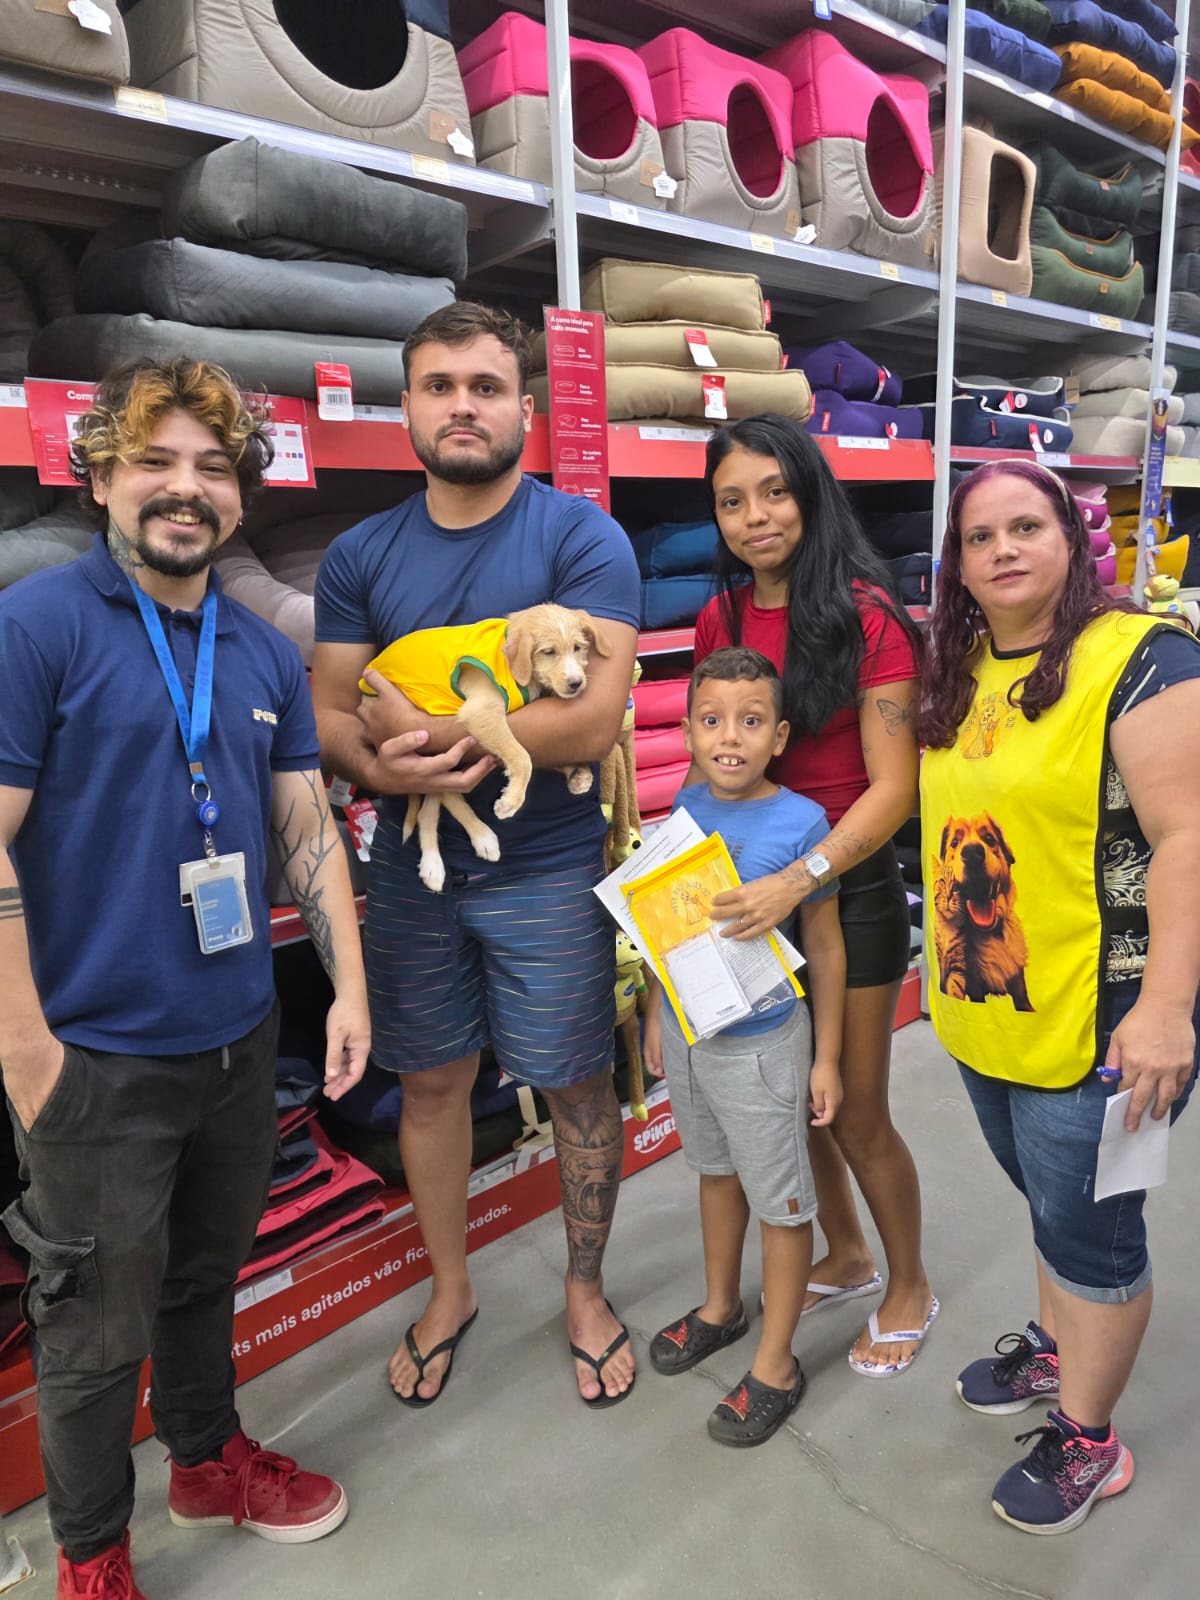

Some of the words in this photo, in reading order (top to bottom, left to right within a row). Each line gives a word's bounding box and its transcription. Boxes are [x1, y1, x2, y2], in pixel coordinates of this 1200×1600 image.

[255, 1314, 298, 1347] mais
[300, 1275, 372, 1322] agitados
[373, 1258, 402, 1281] vão
